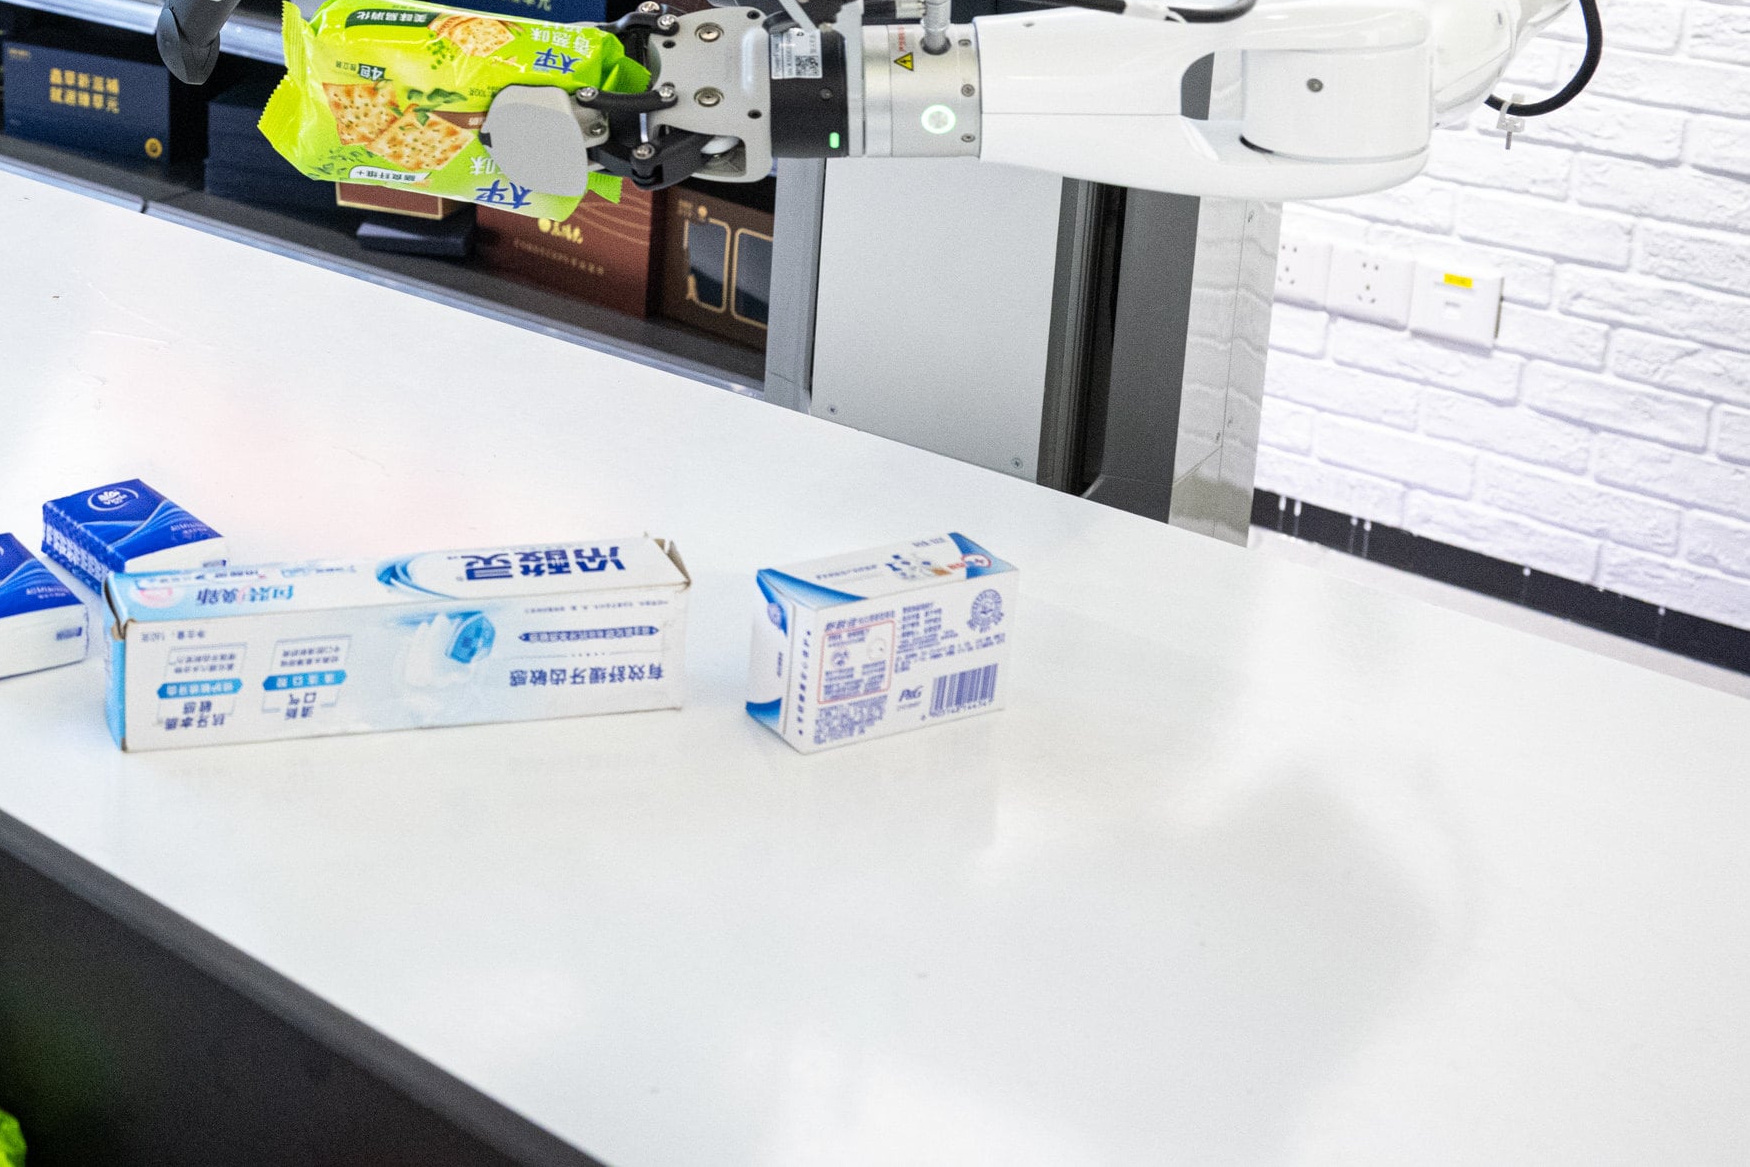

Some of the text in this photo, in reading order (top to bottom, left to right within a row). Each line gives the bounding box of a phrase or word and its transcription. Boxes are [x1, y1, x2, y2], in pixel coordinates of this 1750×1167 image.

[356, 11, 428, 23] 美味易消化
[532, 48, 582, 75] 太平
[474, 180, 533, 209] 太平
[460, 545, 626, 582] 冷酸灵
[509, 663, 665, 688] 有效舒缓牙齿敏感
[289, 692, 317, 706] 口气
